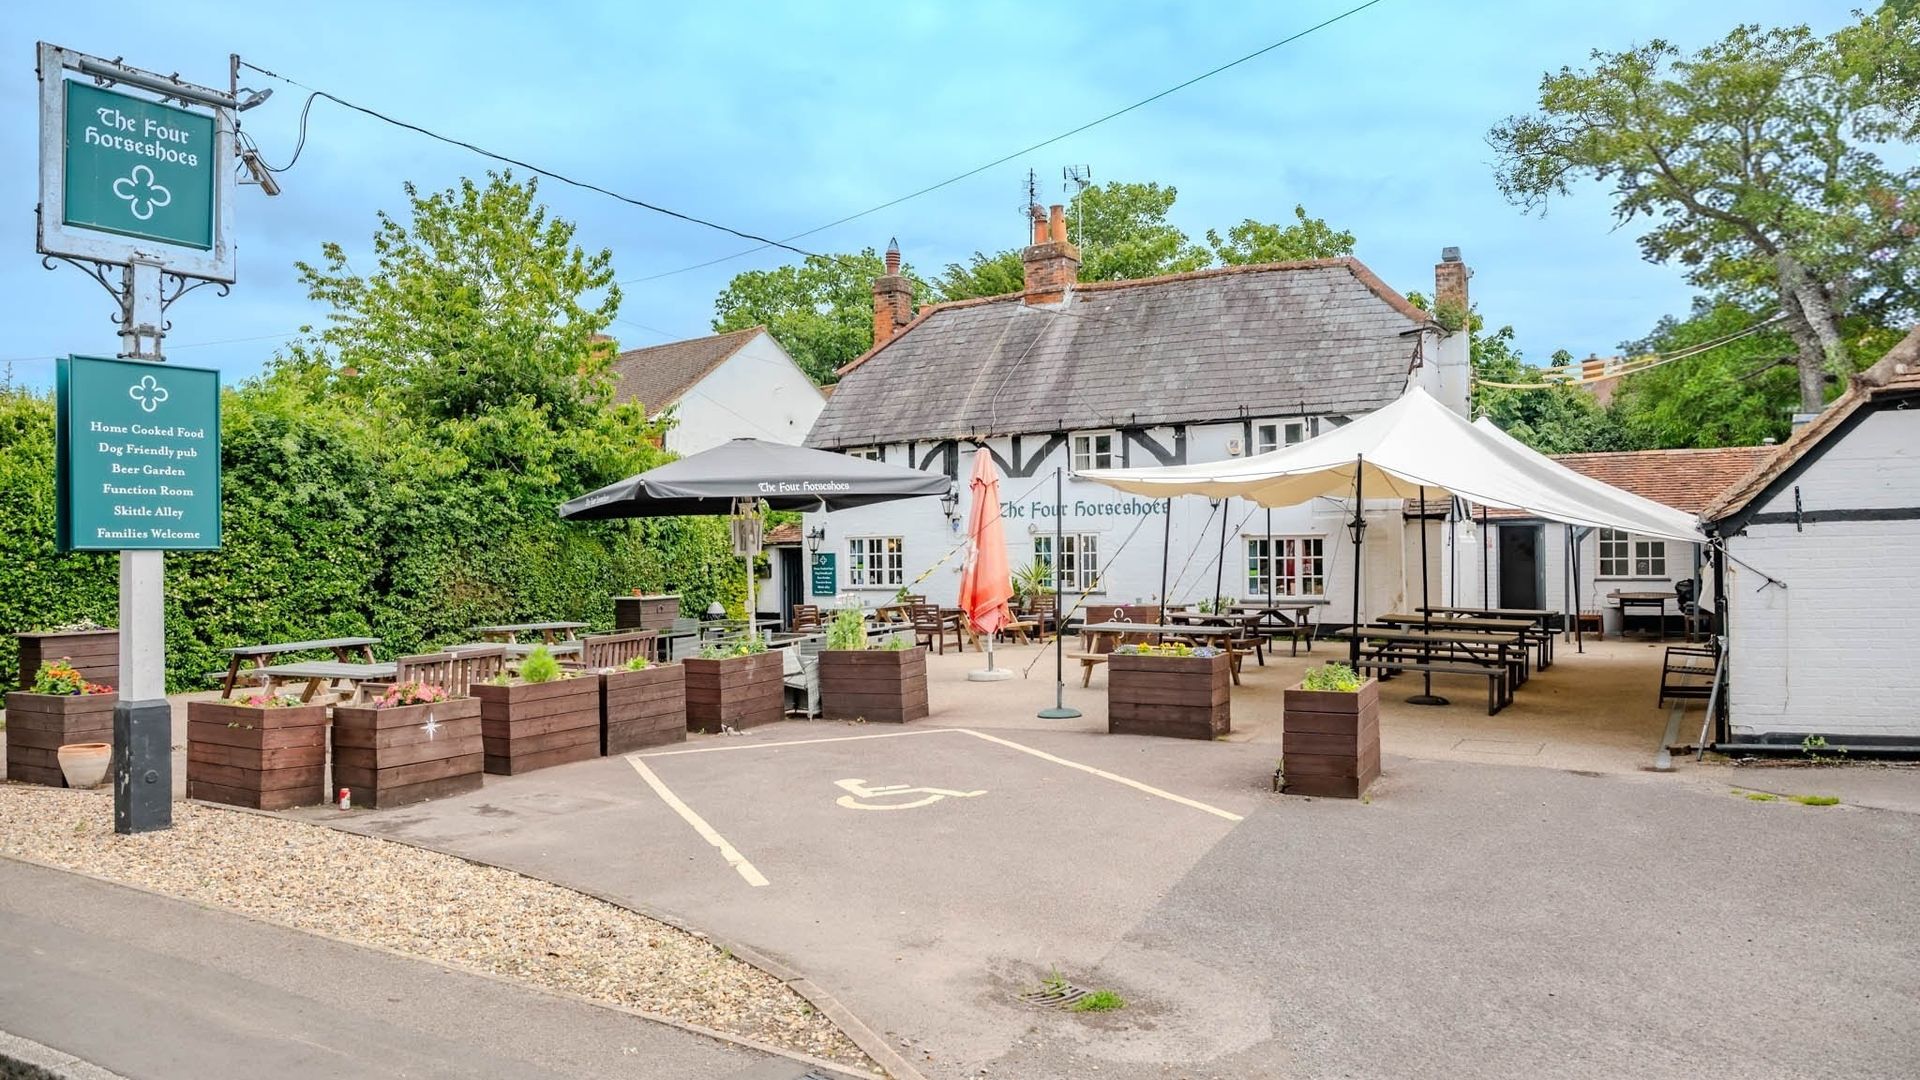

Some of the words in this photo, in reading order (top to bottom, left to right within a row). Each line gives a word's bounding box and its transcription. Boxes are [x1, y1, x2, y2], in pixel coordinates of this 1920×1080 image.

[97, 107, 136, 132] The
[144, 118, 189, 144] Four
[84, 126, 198, 166] Horseshoes
[90, 421, 128, 434] Home
[131, 424, 174, 437] Cooked
[177, 427, 204, 439] Food
[99, 442, 123, 456] Dog
[126, 444, 175, 459] Friendly
[176, 447, 198, 459] pub
[112, 463, 140, 474] Beer
[143, 464, 185, 476] Garden
[103, 483, 157, 496] Function
[160, 486, 194, 497] Room
[757, 481, 776, 493] The
[779, 481, 800, 493] Four
[113, 505, 152, 517] Skittle
[154, 506, 184, 520] Alley
[1000, 500, 1025, 519] The
[1031, 500, 1068, 520] Four
[1074, 497, 1169, 518] Horseshoes
[97, 527, 148, 540] Families
[150, 528, 200, 540] Welcome
